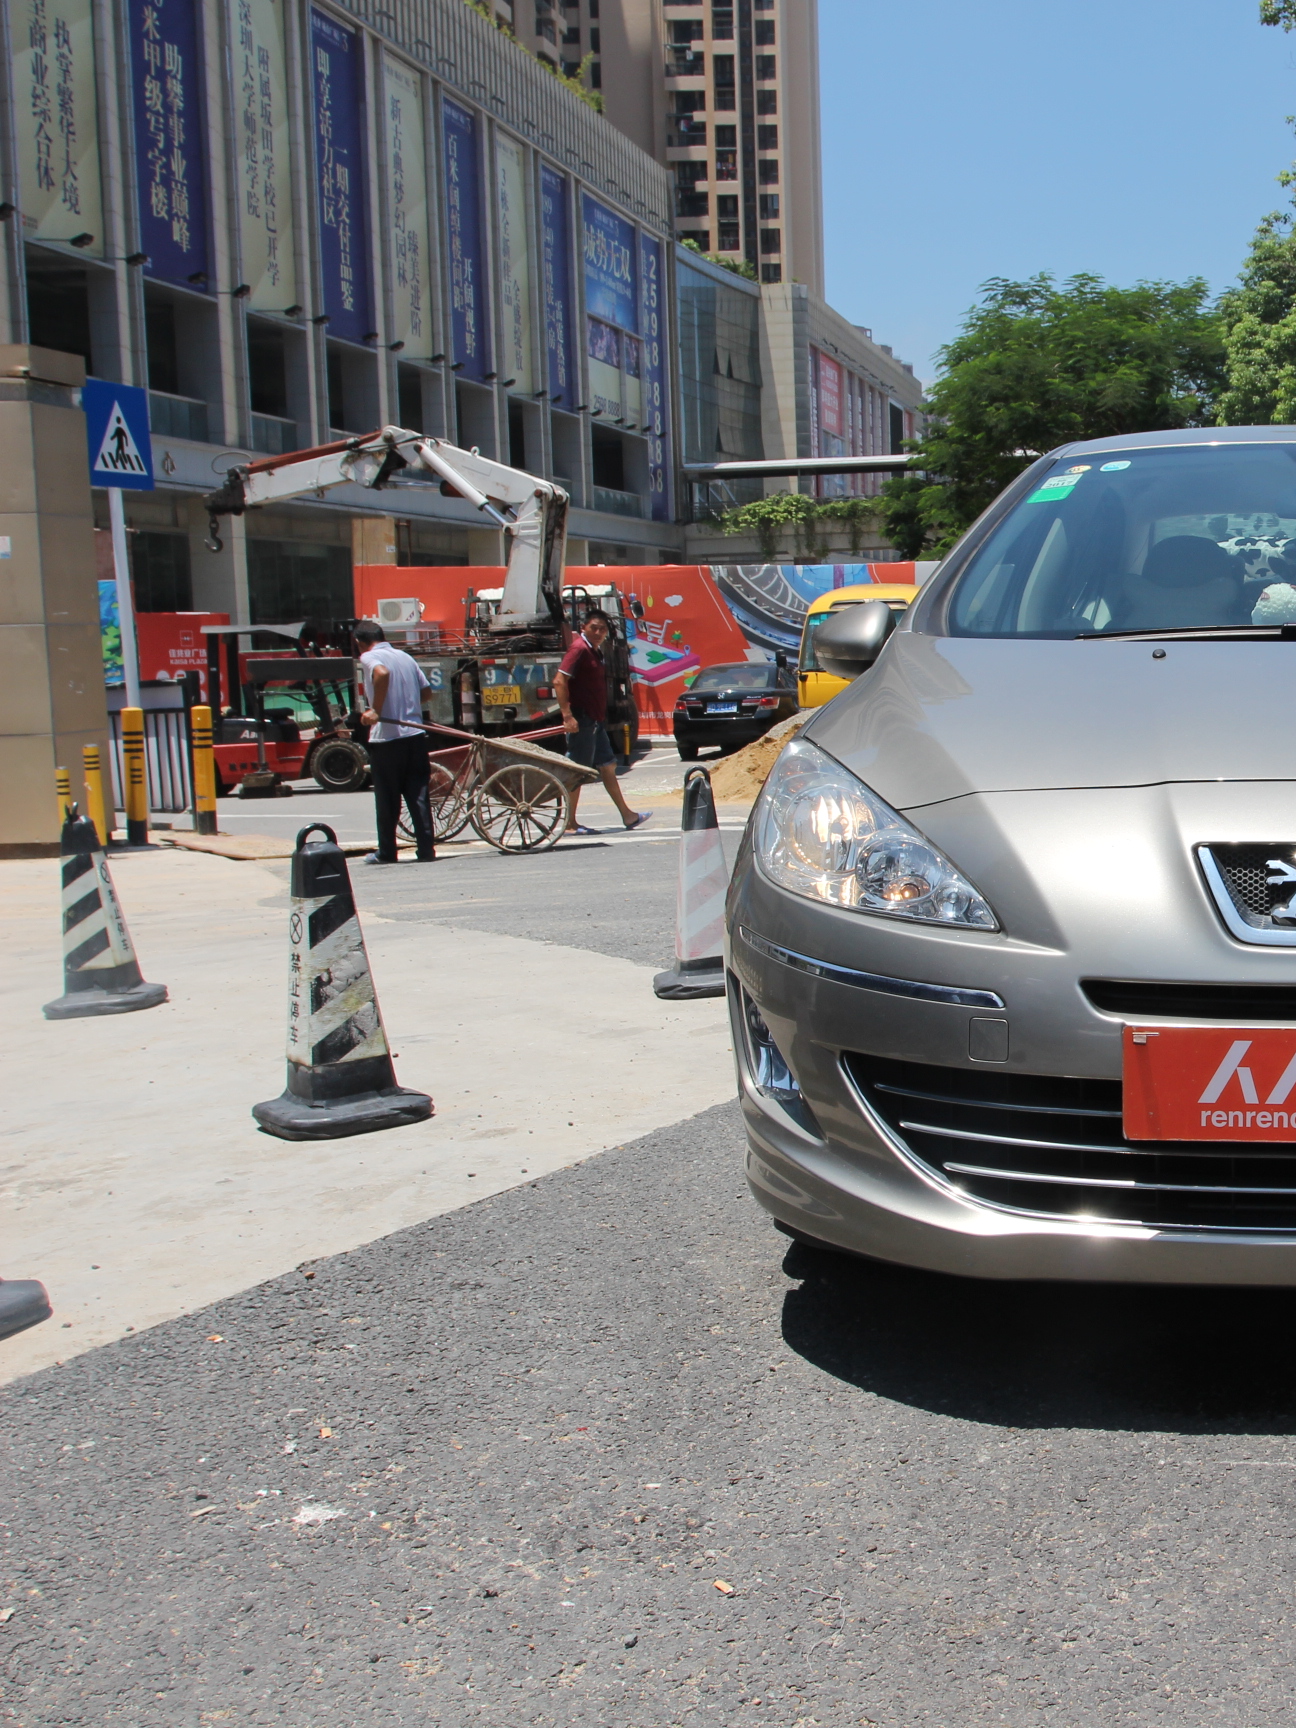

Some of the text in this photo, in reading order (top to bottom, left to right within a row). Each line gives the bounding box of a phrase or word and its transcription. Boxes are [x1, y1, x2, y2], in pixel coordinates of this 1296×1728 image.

[141, 0, 169, 221] 米甲级写字楼
[289, 952, 302, 1048] 禁止停车
